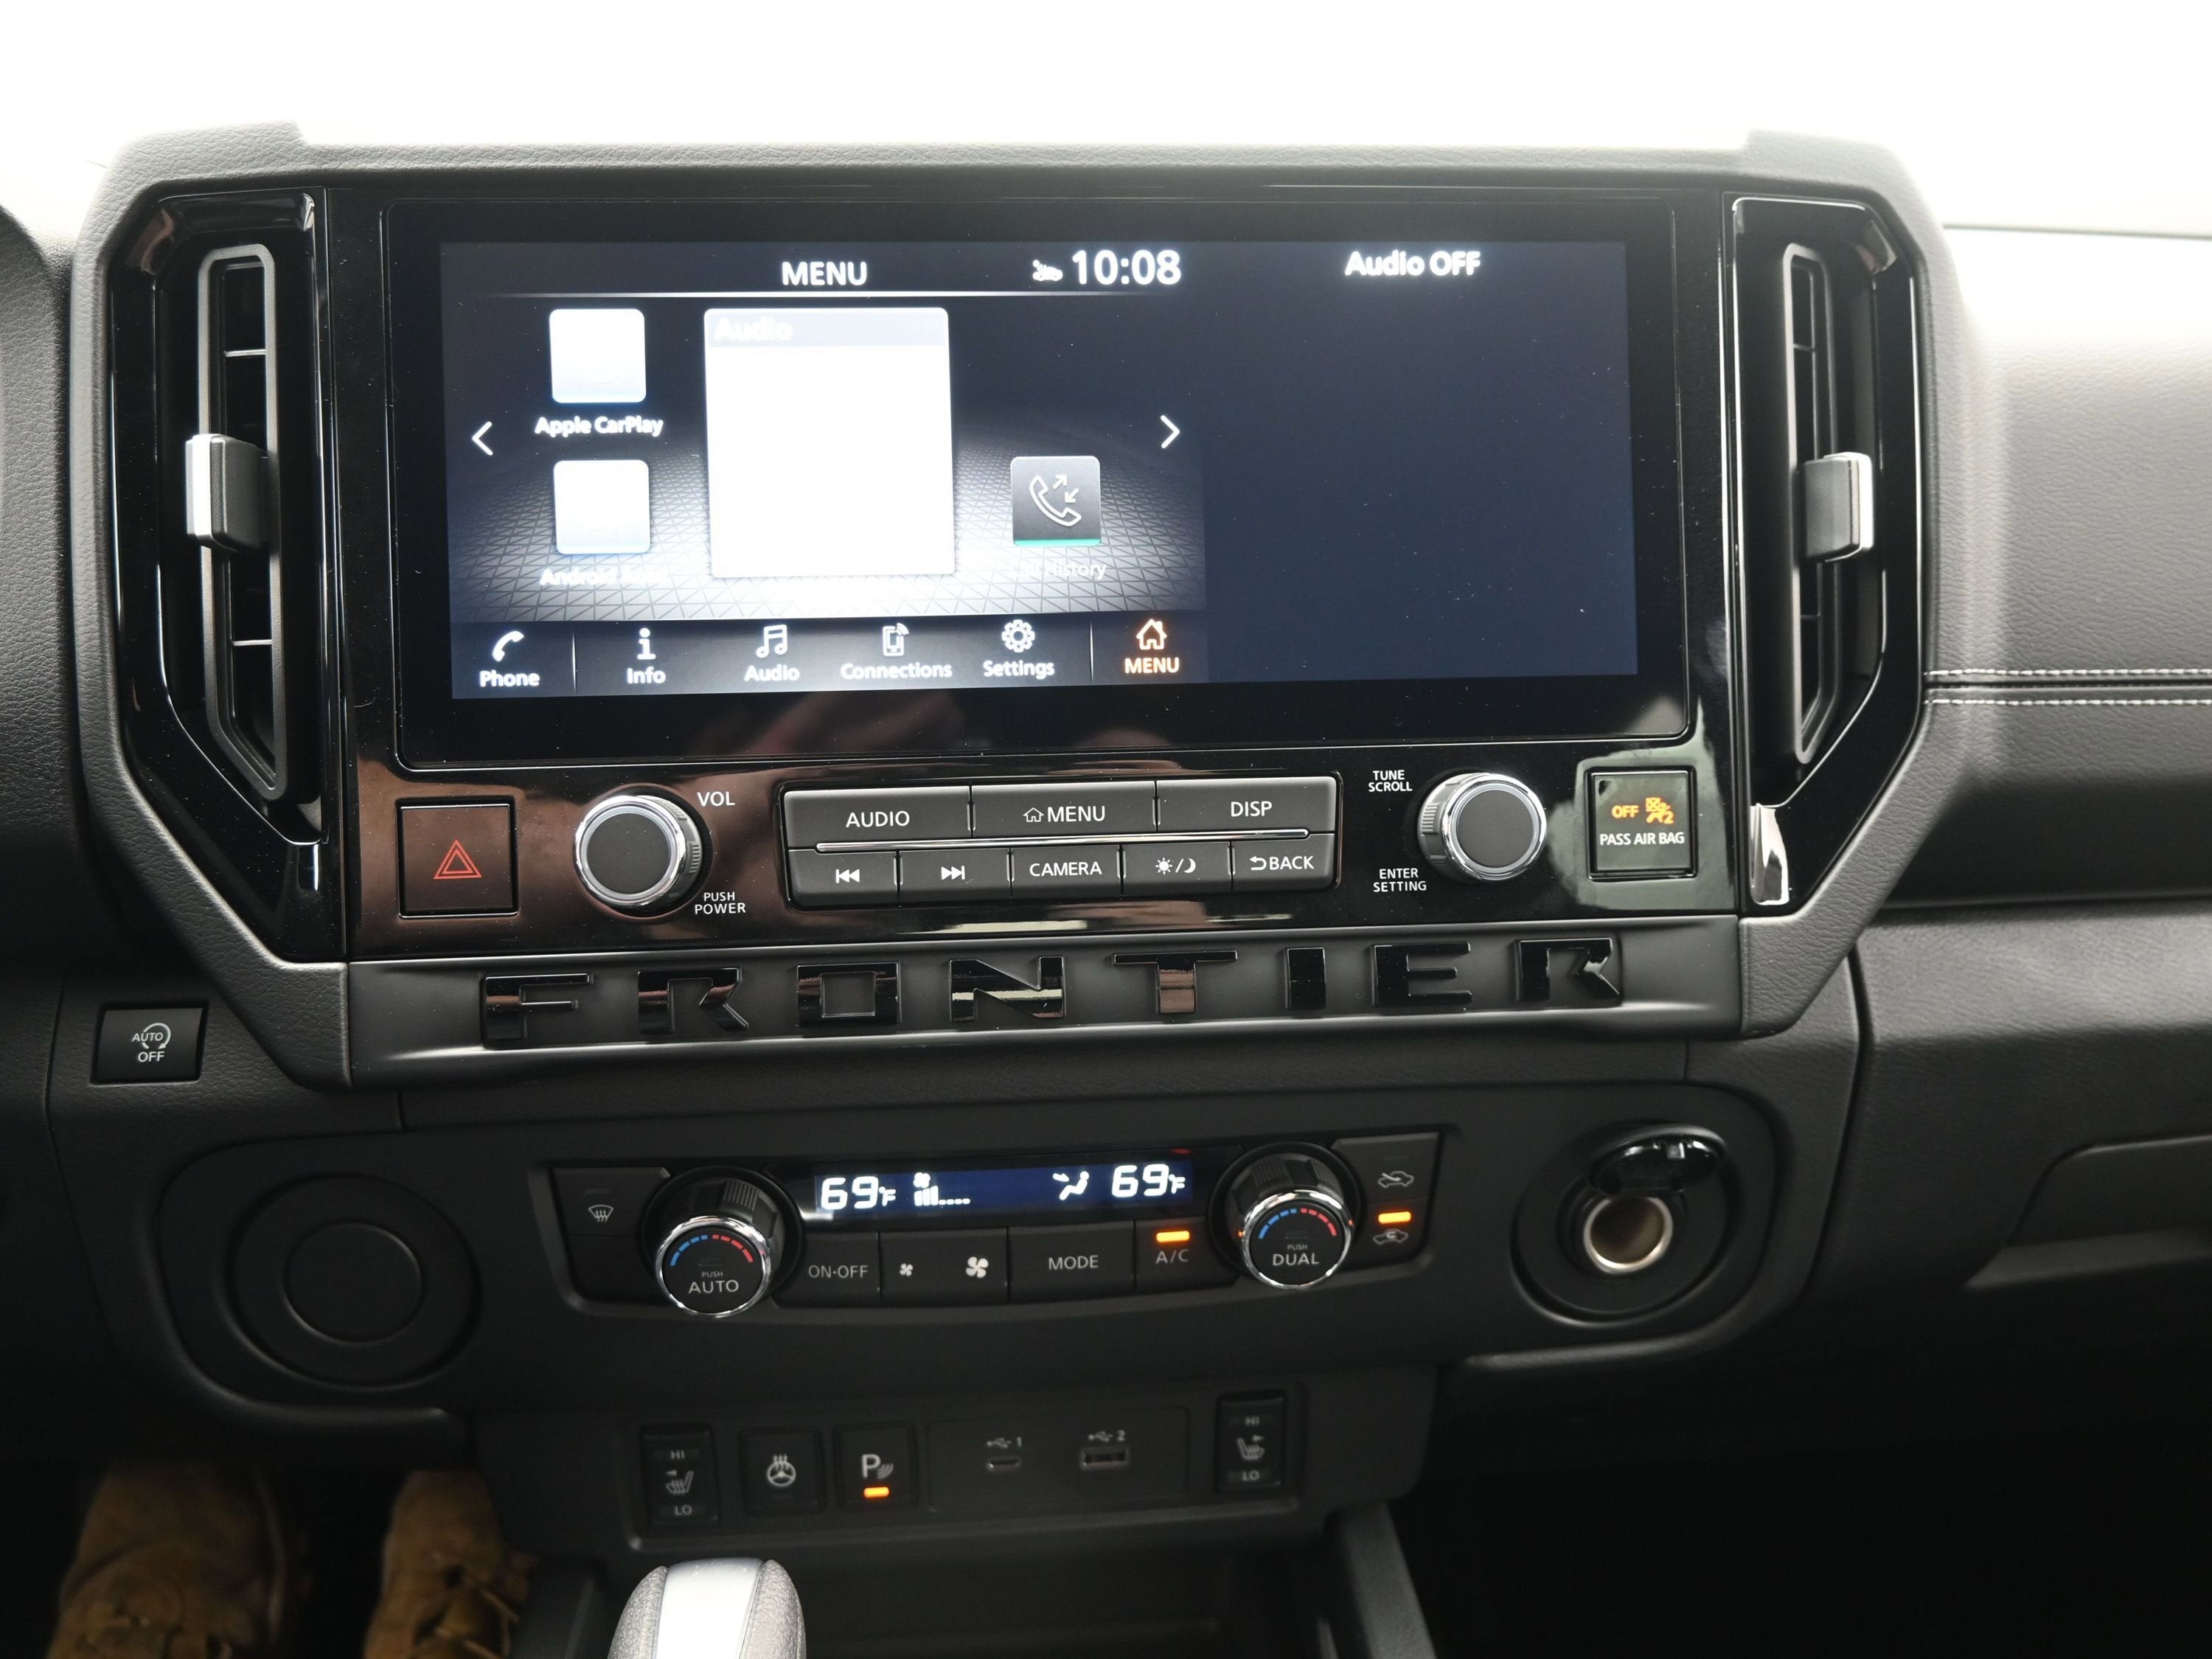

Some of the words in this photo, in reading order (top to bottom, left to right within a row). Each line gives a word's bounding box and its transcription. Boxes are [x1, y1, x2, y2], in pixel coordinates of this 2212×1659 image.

[1071, 248, 1182, 286] 10:08
[1344, 249, 1425, 276] Audio
[1429, 250, 1481, 276] OFF
[781, 260, 868, 286] MENU
[713, 316, 794, 342] Audio
[534, 415, 592, 438] Apple
[594, 415, 664, 438] CarPlay
[744, 664, 801, 682] Audio
[839, 662, 953, 680] Connections
[983, 660, 1055, 680] Settings
[1124, 656, 1180, 674] MENU
[479, 669, 540, 687] Phone
[626, 667, 667, 684] Info
[1372, 769, 1405, 782] TUNE
[1368, 780, 1413, 793] SCROLL
[697, 791, 736, 807] VOL
[1047, 805, 1106, 823] MENU
[1231, 801, 1273, 818] DISP
[1611, 804, 1640, 819] OFF
[845, 810, 911, 829] AUDIO
[1599, 832, 1632, 846] PASS
[1633, 832, 1657, 845] AIR
[1658, 831, 1686, 844] BAG
[1029, 860, 1103, 877] CAMERA
[1268, 855, 1315, 872] BACK
[1378, 867, 1419, 880] ENTER
[1373, 880, 1427, 894] SETTING
[703, 891, 736, 903] PUSH
[694, 902, 746, 916] POWER
[481, 937, 1620, 1048] FRONTIER
[131, 1032, 164, 1043] AUTO
[137, 1050, 165, 1063] OFF
[1286, 1243, 1309, 1251] PUSH
[1048, 1254, 1100, 1271] MODE
[1155, 1248, 1189, 1265] A/C
[1271, 1252, 1320, 1267] DUAL
[700, 1270, 724, 1279] PUSH
[688, 1279, 740, 1295] AUTO
[1245, 1416, 1259, 1426] HI
[670, 1450, 686, 1460] HI
[1242, 1470, 1260, 1481] LO
[674, 1504, 692, 1516] LO
